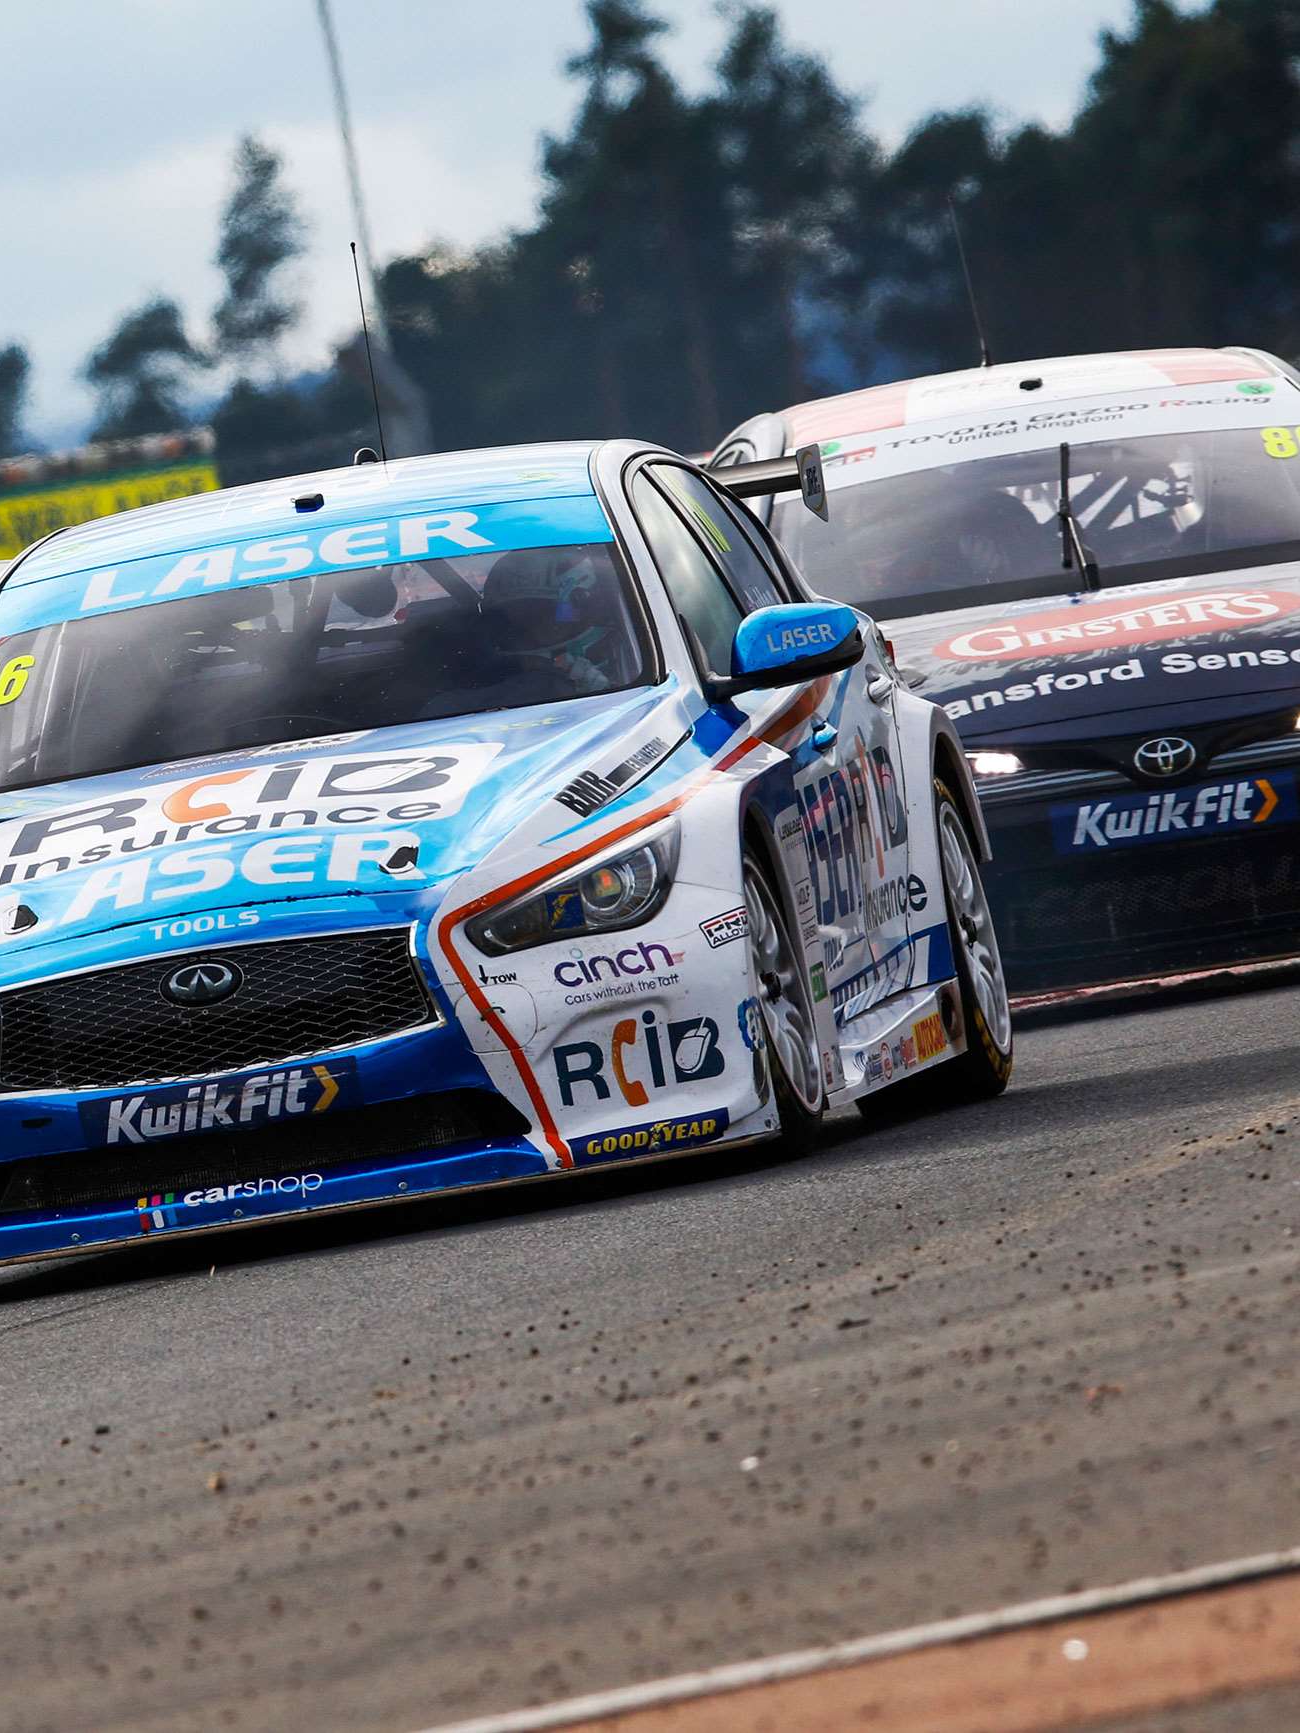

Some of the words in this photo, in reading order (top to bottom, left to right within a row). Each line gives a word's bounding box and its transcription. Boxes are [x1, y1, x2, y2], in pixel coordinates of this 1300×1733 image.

[885, 419, 1018, 449] TOYOTA
[1028, 402, 1150, 423] GAZOO
[1158, 394, 1271, 409] Racing
[948, 425, 1018, 446] United
[1022, 412, 1124, 435] Kingdom
[1261, 427, 1300, 459] 8
[79, 511, 495, 611] LASER
[765, 623, 836, 654] LASER
[949, 592, 1280, 658] GINSTERS
[946, 659, 1145, 721] ansford
[1160, 648, 1300, 674] Sens
[149, 909, 261, 940] TOOLS
[491, 971, 518, 984] TOW
[553, 941, 676, 988] cinch
[564, 993, 593, 1006] Cars
[593, 983, 636, 1001] without
[638, 979, 656, 992] the
[183, 1172, 323, 1208] carshop
